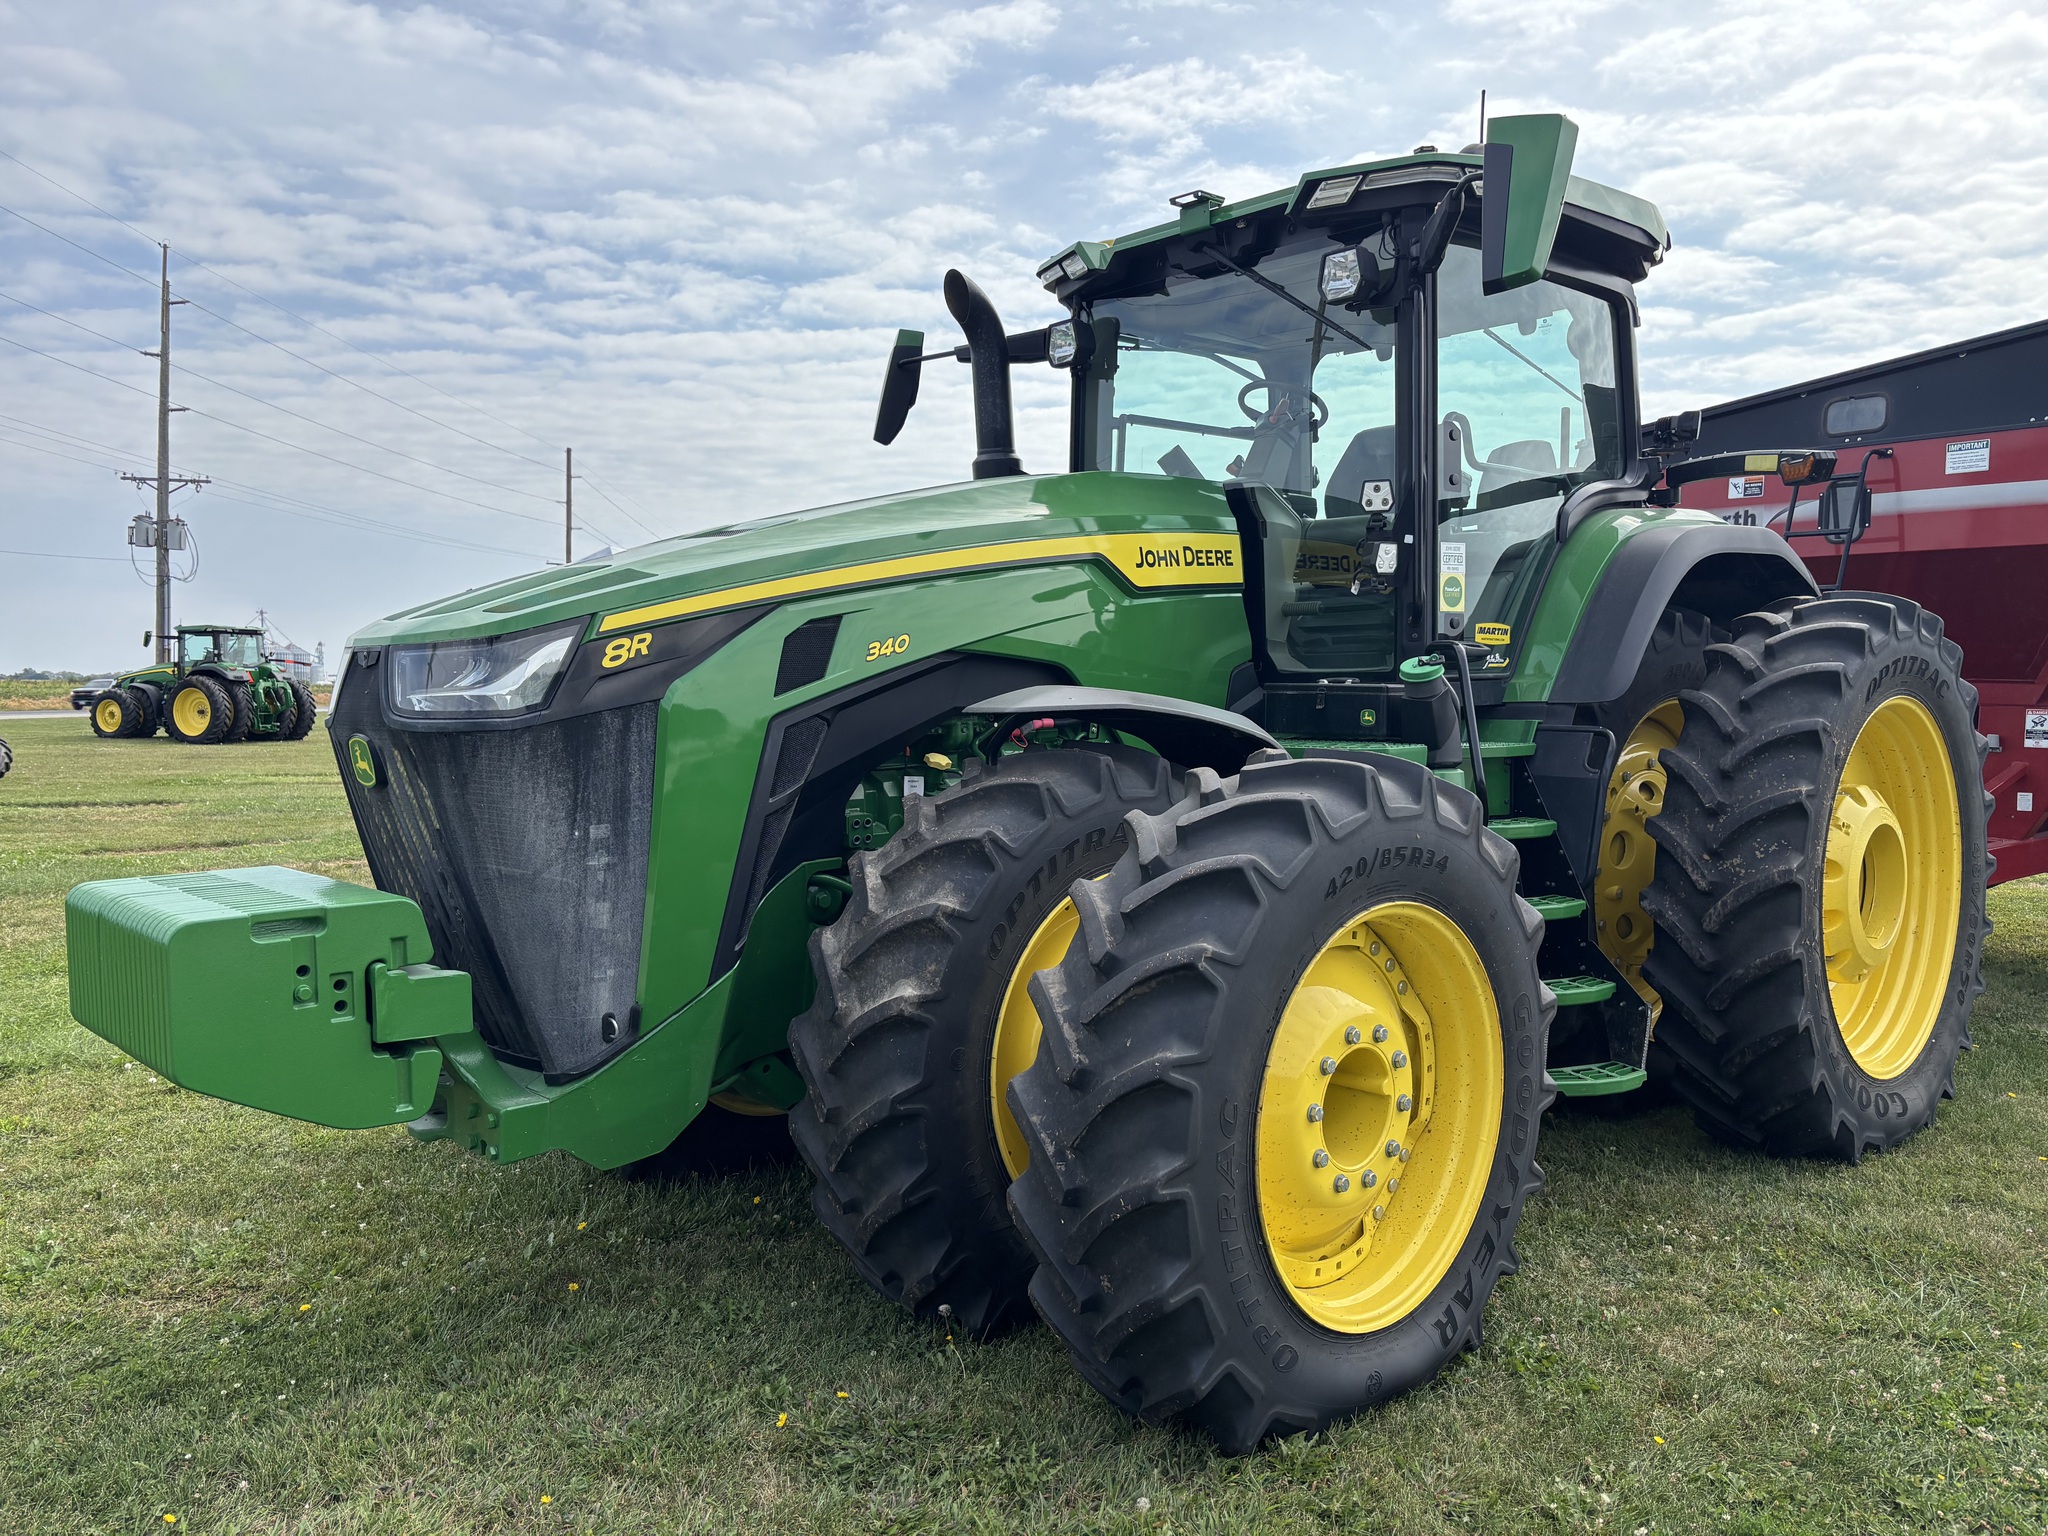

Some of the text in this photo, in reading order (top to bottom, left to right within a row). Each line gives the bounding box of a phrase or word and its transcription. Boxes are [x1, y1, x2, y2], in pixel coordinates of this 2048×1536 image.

[1948, 441, 1988, 452] IMPORTANT
[1135, 546, 1233, 568] JOHN DEERE
[865, 633, 911, 662] 340
[1479, 626, 1509, 636] MARTIN
[602, 632, 653, 668] 8R
[1865, 656, 1950, 702] OPTITRAC
[988, 821, 1128, 960] OPTITRA
[1324, 846, 1450, 902] 420/85R34
[1216, 1098, 1299, 1373] OPTITRAC
